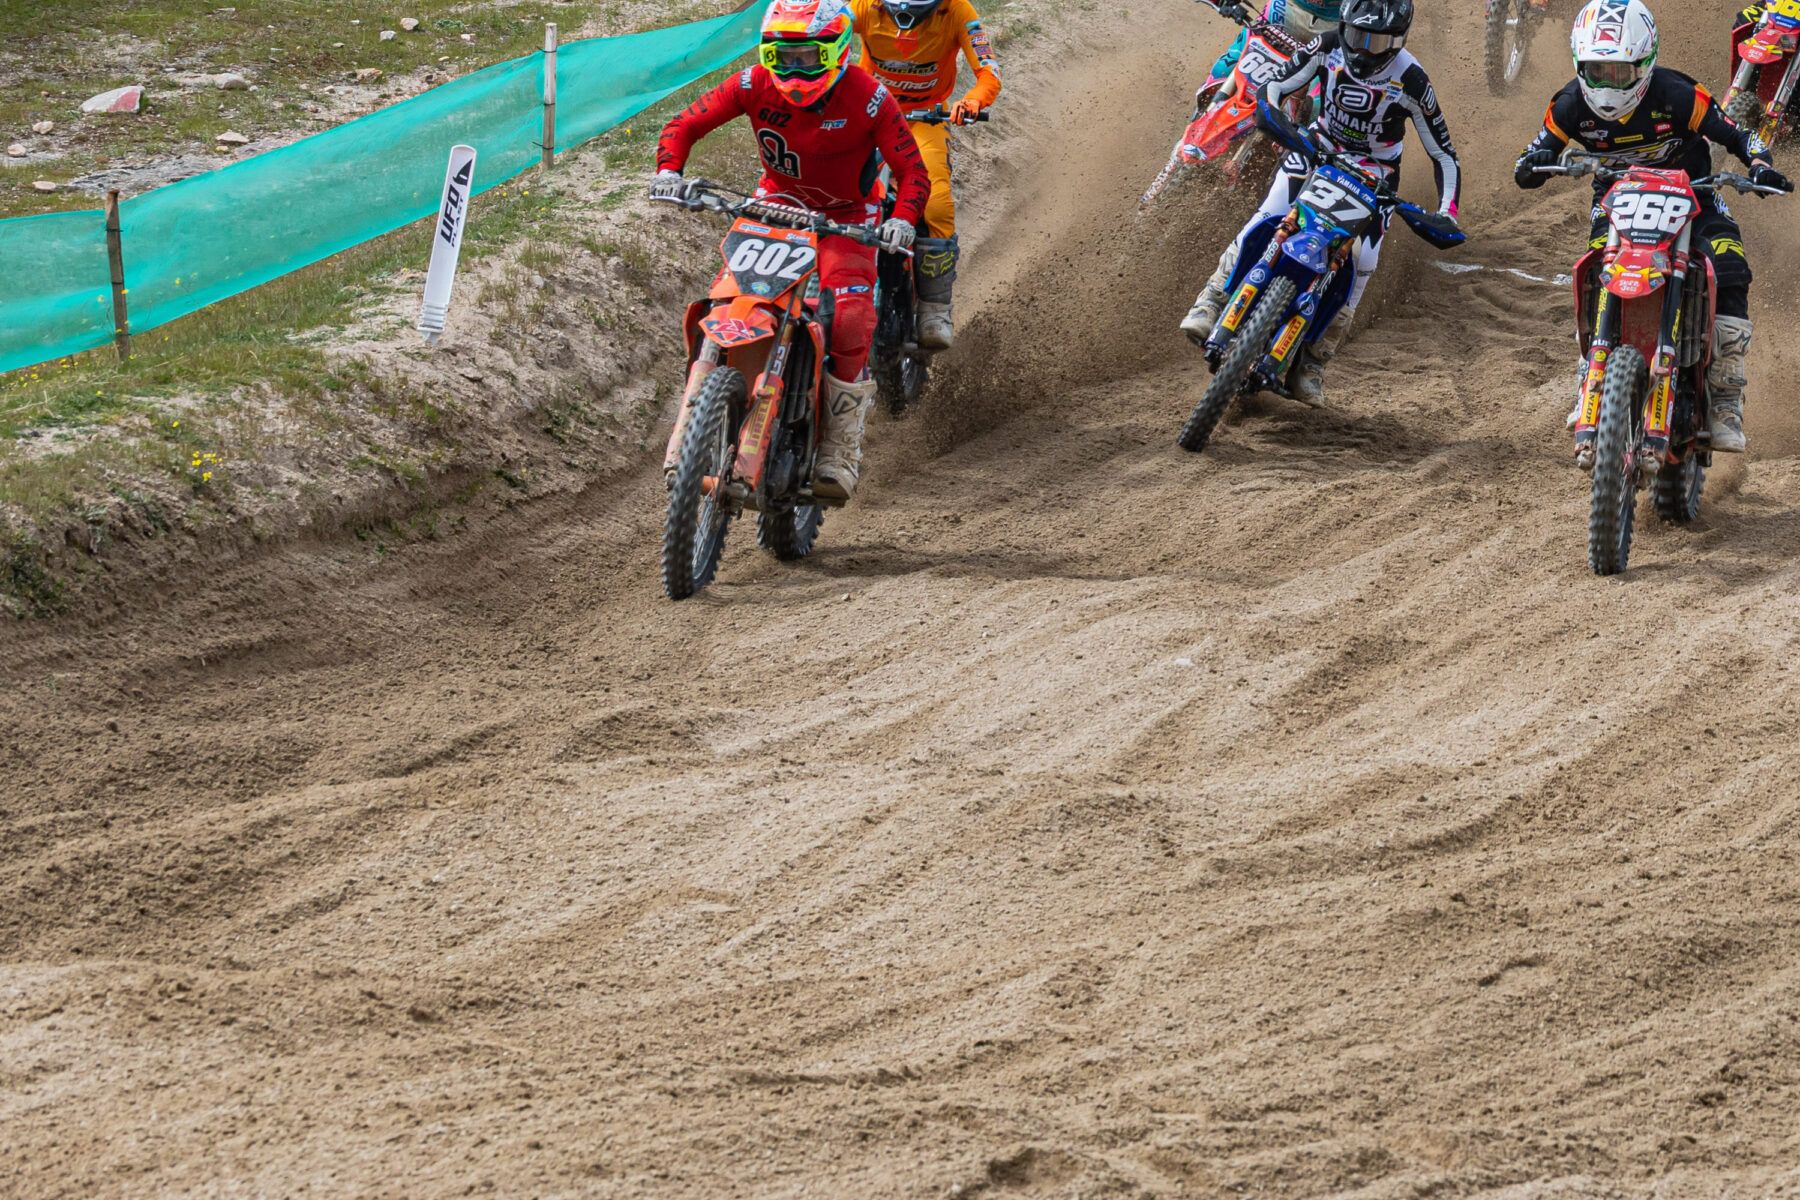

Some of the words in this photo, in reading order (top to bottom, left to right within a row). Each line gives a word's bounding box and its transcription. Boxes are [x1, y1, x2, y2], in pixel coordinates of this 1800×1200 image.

[758, 107, 793, 129] 602
[1324, 98, 1384, 135] YAMAHA
[1299, 178, 1373, 223] 37
[1336, 174, 1361, 196] YAMAHA
[1659, 184, 1687, 195] TAPIA
[440, 183, 460, 244] UFO
[450, 197, 465, 248] PLAST
[1610, 192, 1693, 235] 268
[728, 237, 817, 282] 602
